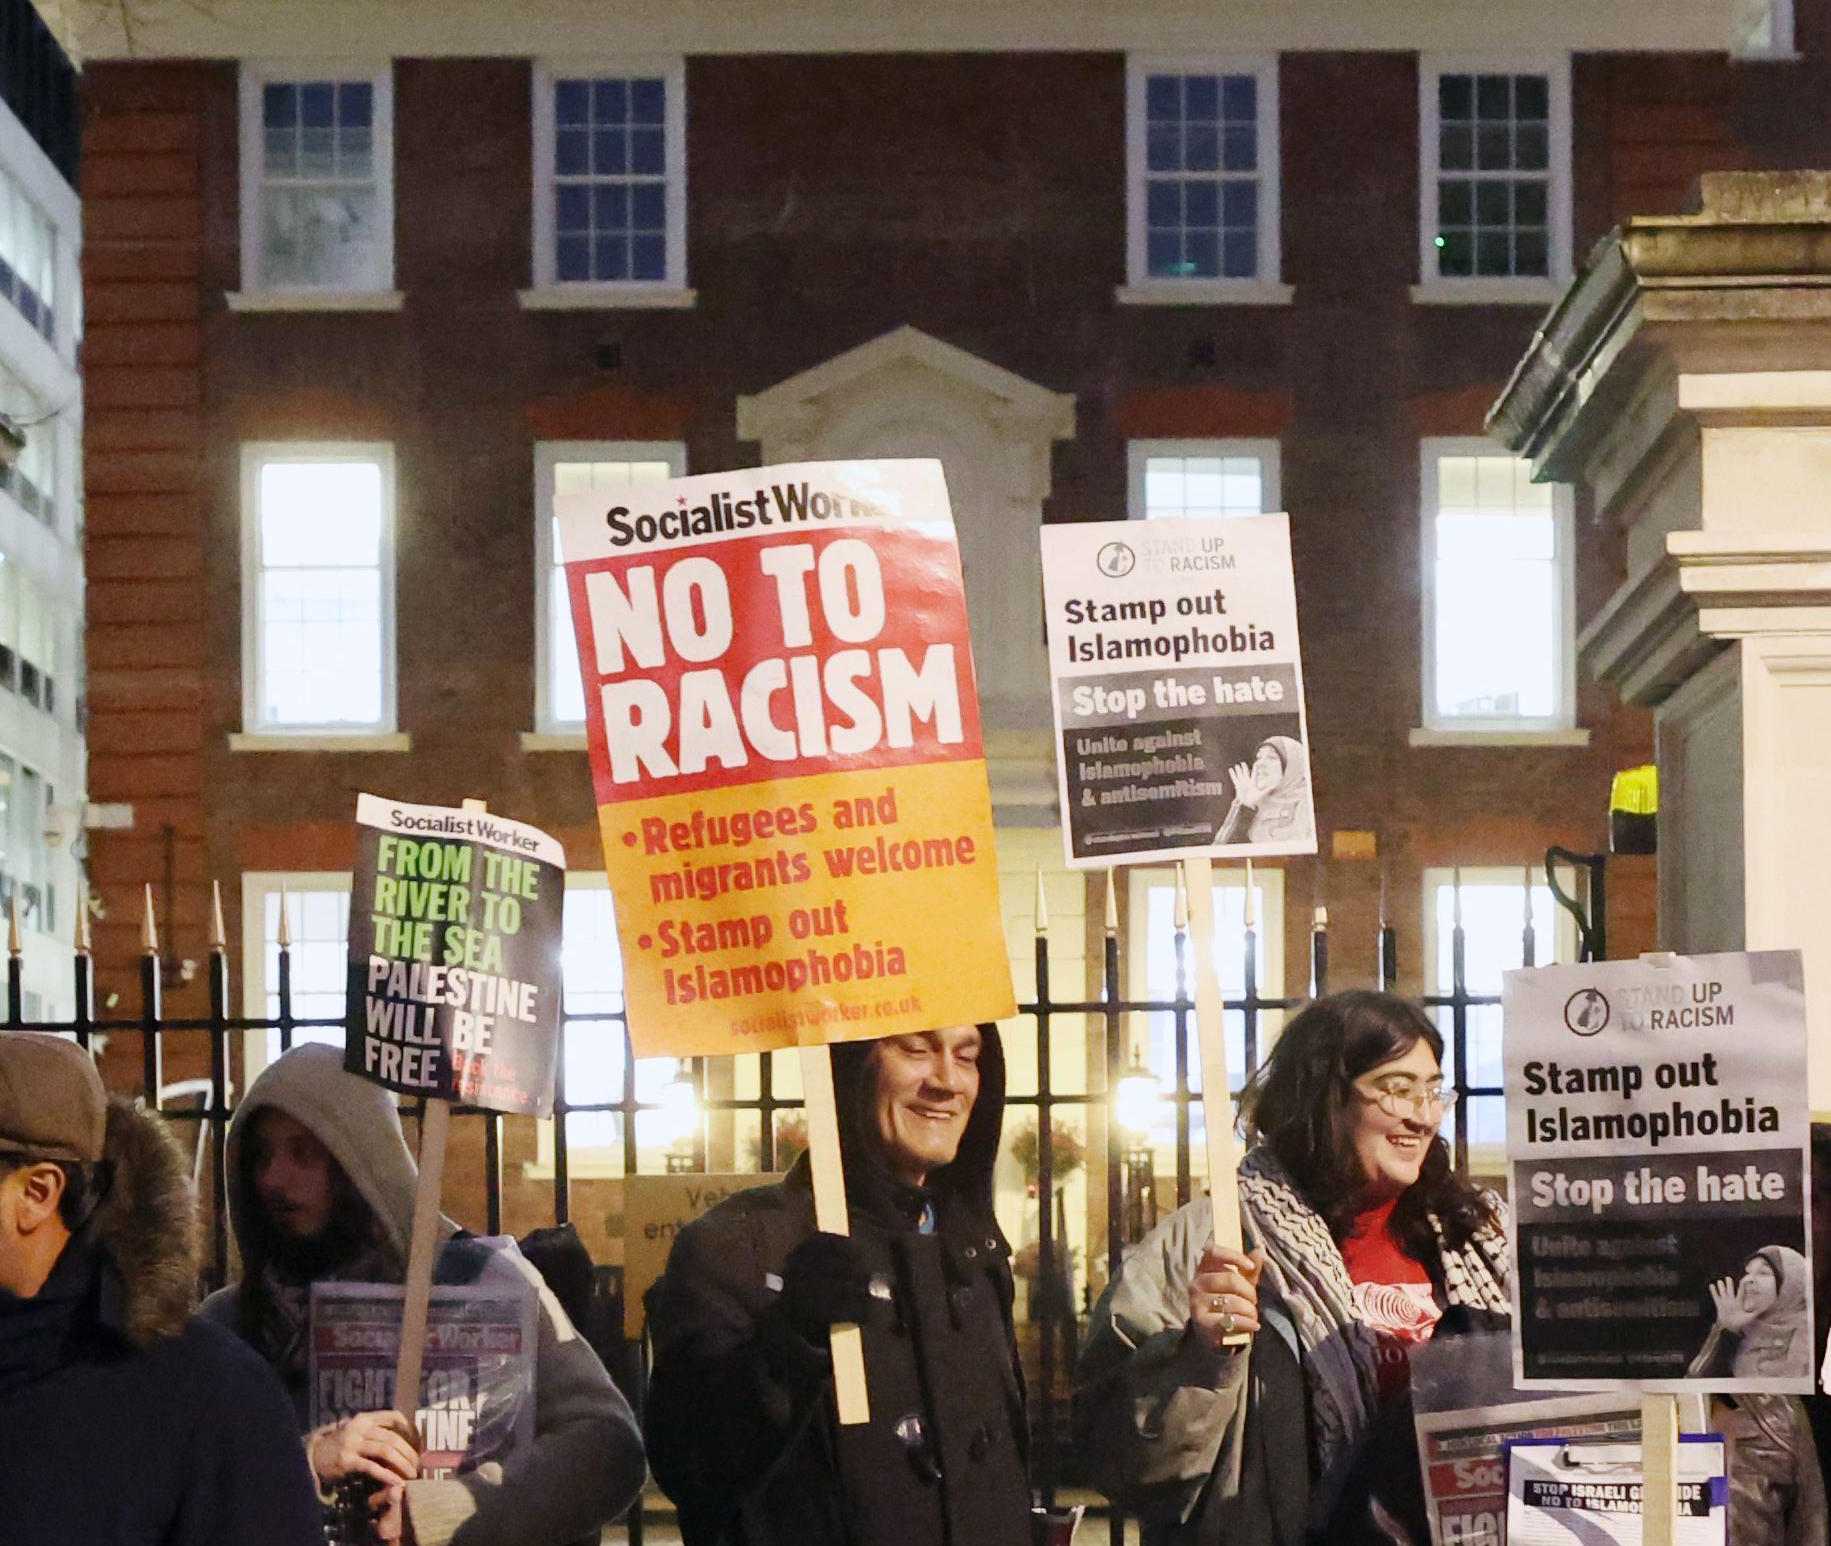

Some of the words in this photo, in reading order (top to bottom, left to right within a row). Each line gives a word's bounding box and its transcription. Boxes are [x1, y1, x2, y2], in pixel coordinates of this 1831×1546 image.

[606, 490, 773, 547] Socialist
[1170, 556, 1237, 573] RACISM
[1202, 538, 1225, 554] UP
[585, 556, 734, 676] NO
[760, 539, 886, 649] TO
[1064, 599, 1167, 625] Stamp
[1177, 590, 1228, 617] out
[1068, 624, 1276, 664] Islamophobia
[600, 643, 964, 785] RACISM
[1072, 684, 1147, 719] Stop
[1153, 678, 1207, 709] the
[1213, 675, 1285, 705] hate
[1076, 735, 1129, 757] Unite
[391, 810, 474, 835] Socialist
[476, 818, 540, 853] Worker
[641, 803, 818, 855] Refugees
[832, 788, 898, 830] and
[377, 835, 472, 883] FROM
[484, 850, 541, 901] THE
[649, 850, 811, 904] migrants
[823, 835, 977, 879] welcome
[374, 875, 471, 924] RIVER
[481, 891, 522, 936] TO
[658, 915, 773, 959] Stamp
[789, 900, 849, 939] out
[371, 915, 434, 963] THE
[443, 925, 504, 974] SEA
[368, 954, 539, 1024] PALESTINE
[664, 941, 907, 1006] Islamophobia
[1692, 982, 1723, 1004] UP
[366, 995, 442, 1046] WILL
[453, 1010, 495, 1056] BE
[1650, 1004, 1735, 1031] RACISM
[364, 1036, 441, 1088] FREE
[1523, 1061, 1643, 1099] Stamp
[1655, 1052, 1719, 1089] out
[1527, 1097, 1780, 1148] Islamophobia
[1531, 1170, 1615, 1214] Stop
[1623, 1166, 1687, 1205] the
[1696, 1165, 1786, 1203] hate
[1533, 1482, 1569, 1496] STOP
[1571, 1483, 1626, 1500] ISRAELI
